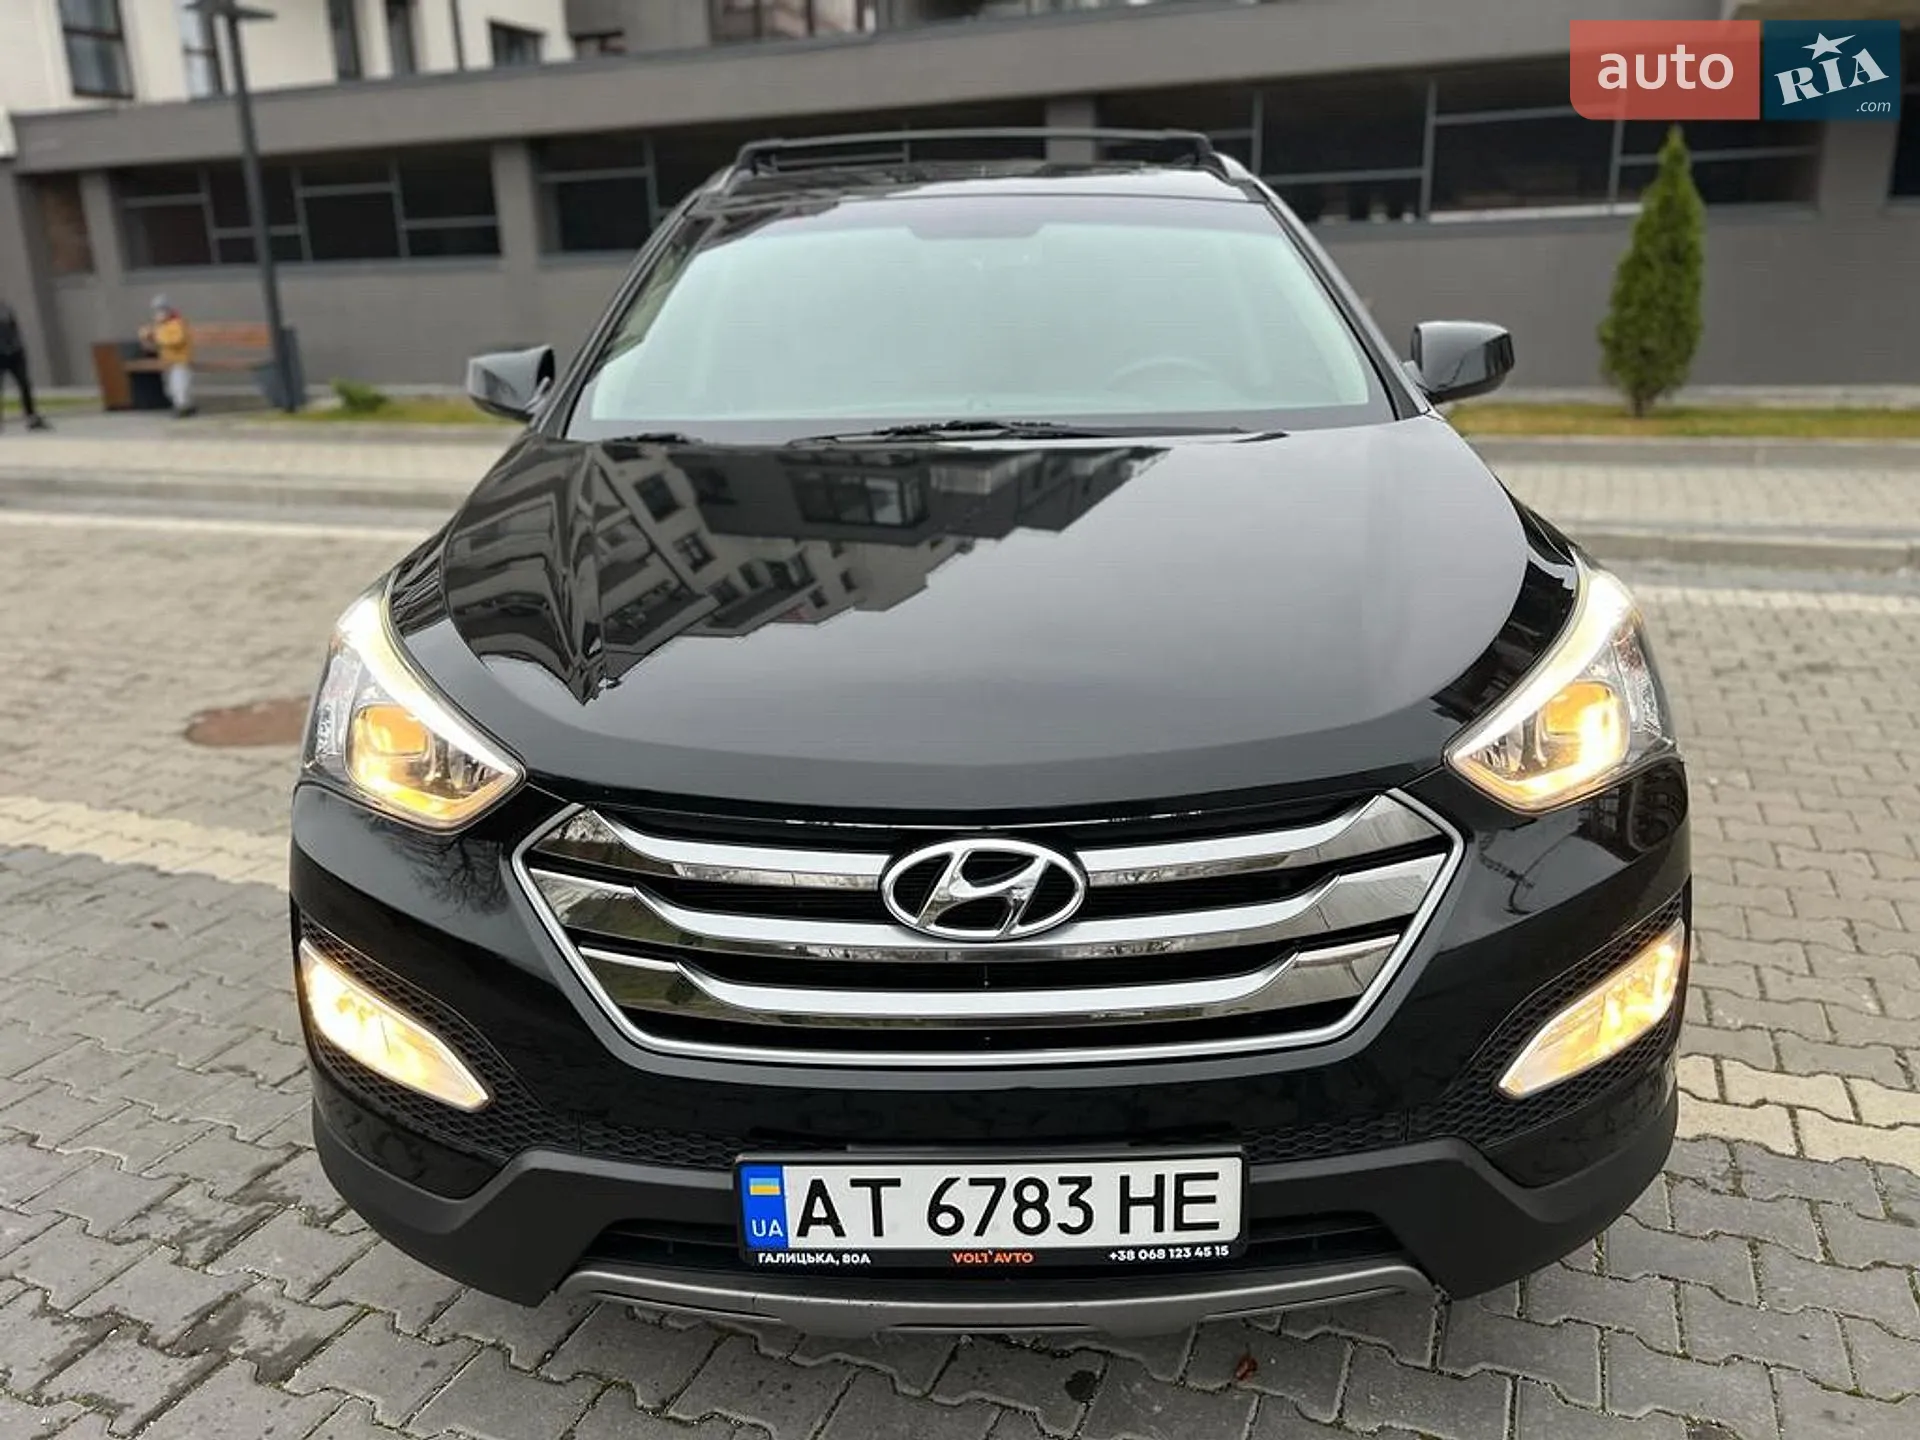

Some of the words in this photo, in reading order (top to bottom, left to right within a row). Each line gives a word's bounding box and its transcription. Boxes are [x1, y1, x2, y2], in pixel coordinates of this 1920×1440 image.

[796, 1177, 901, 1238] AT
[927, 1176, 1094, 1237] 6783
[1119, 1171, 1220, 1235] HE
[751, 1218, 784, 1237] UA
[1109, 1249, 1136, 1262] +38
[1138, 1248, 1166, 1260] 068
[1168, 1247, 1192, 1259] 123
[1194, 1246, 1212, 1258] 45
[1214, 1245, 1230, 1257] 15
